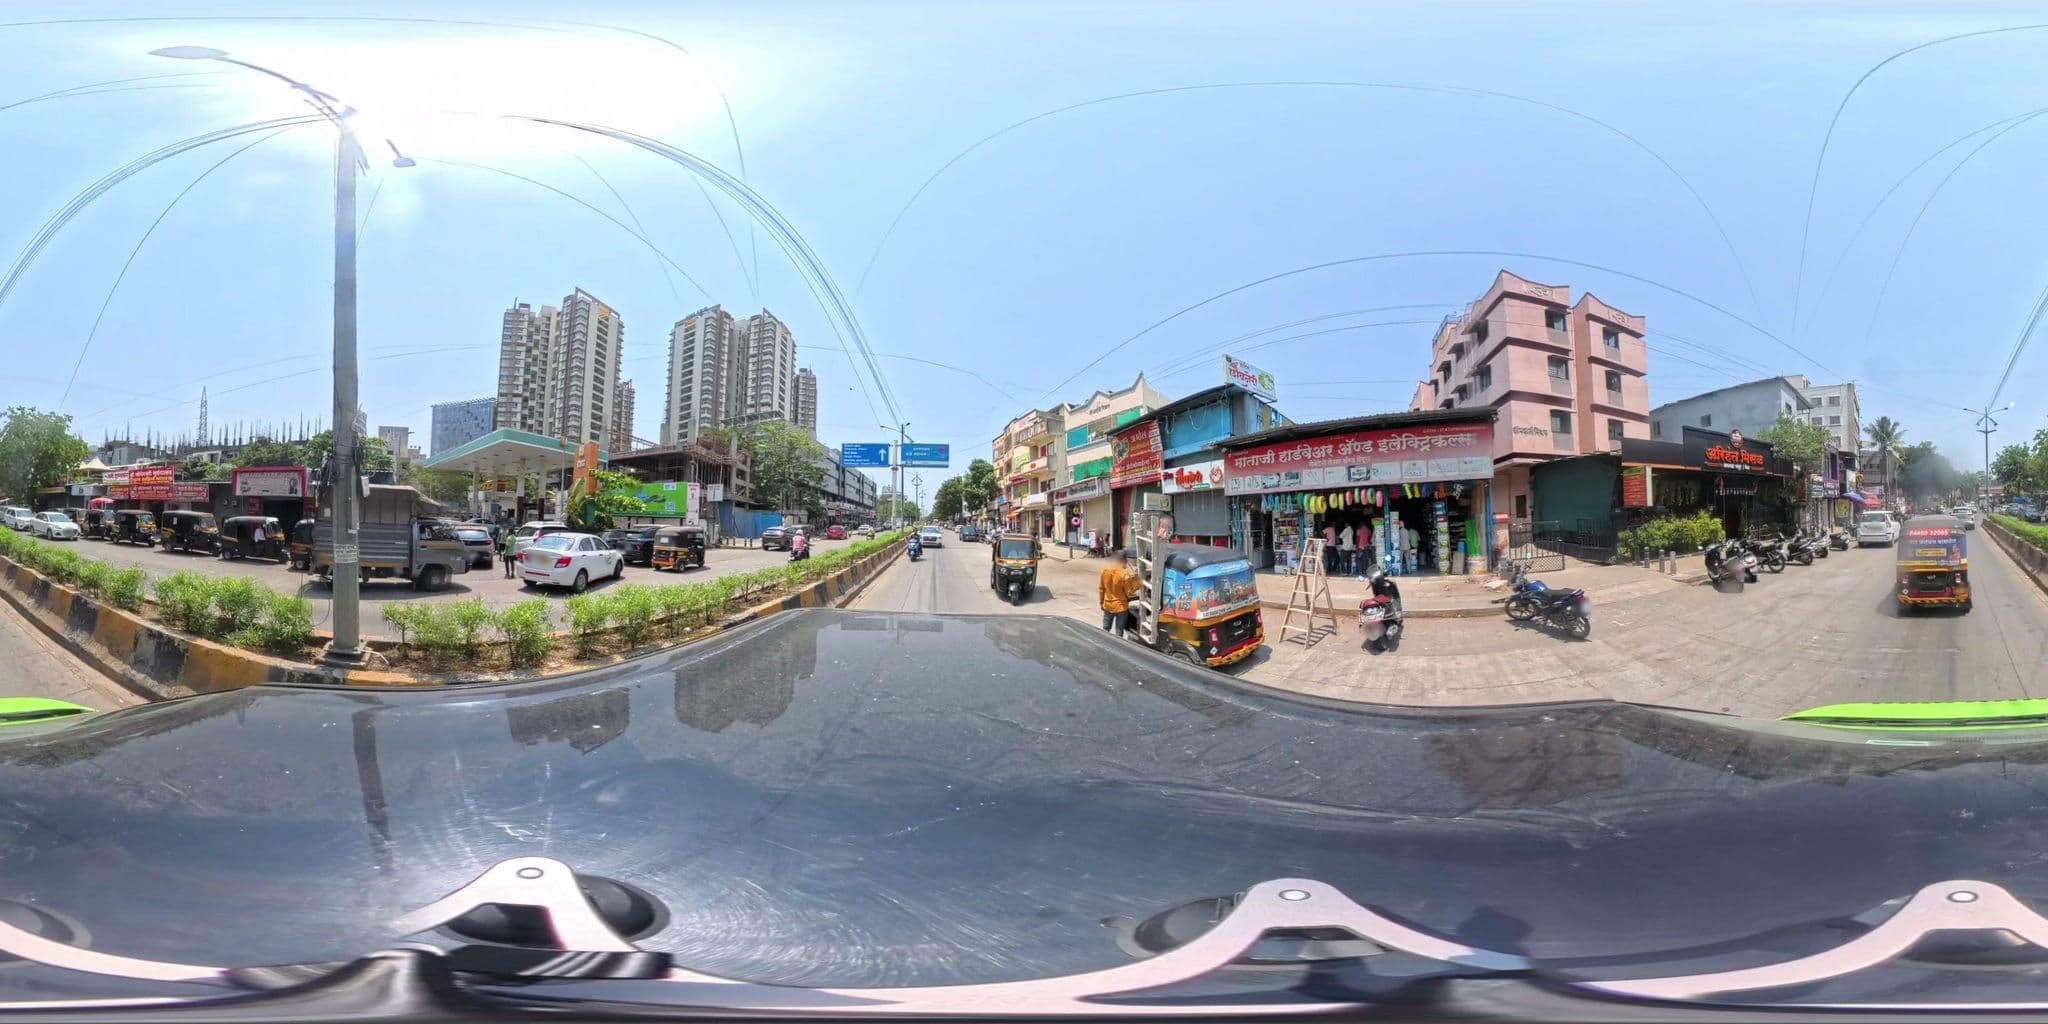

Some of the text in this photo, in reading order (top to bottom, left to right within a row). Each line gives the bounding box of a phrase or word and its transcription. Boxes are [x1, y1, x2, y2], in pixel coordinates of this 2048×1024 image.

[1235, 449, 1276, 468] माताजी
[1278, 444, 1334, 464] हार्डवेअर
[1377, 432, 1477, 453] इलेक्ट्रिकल्स
